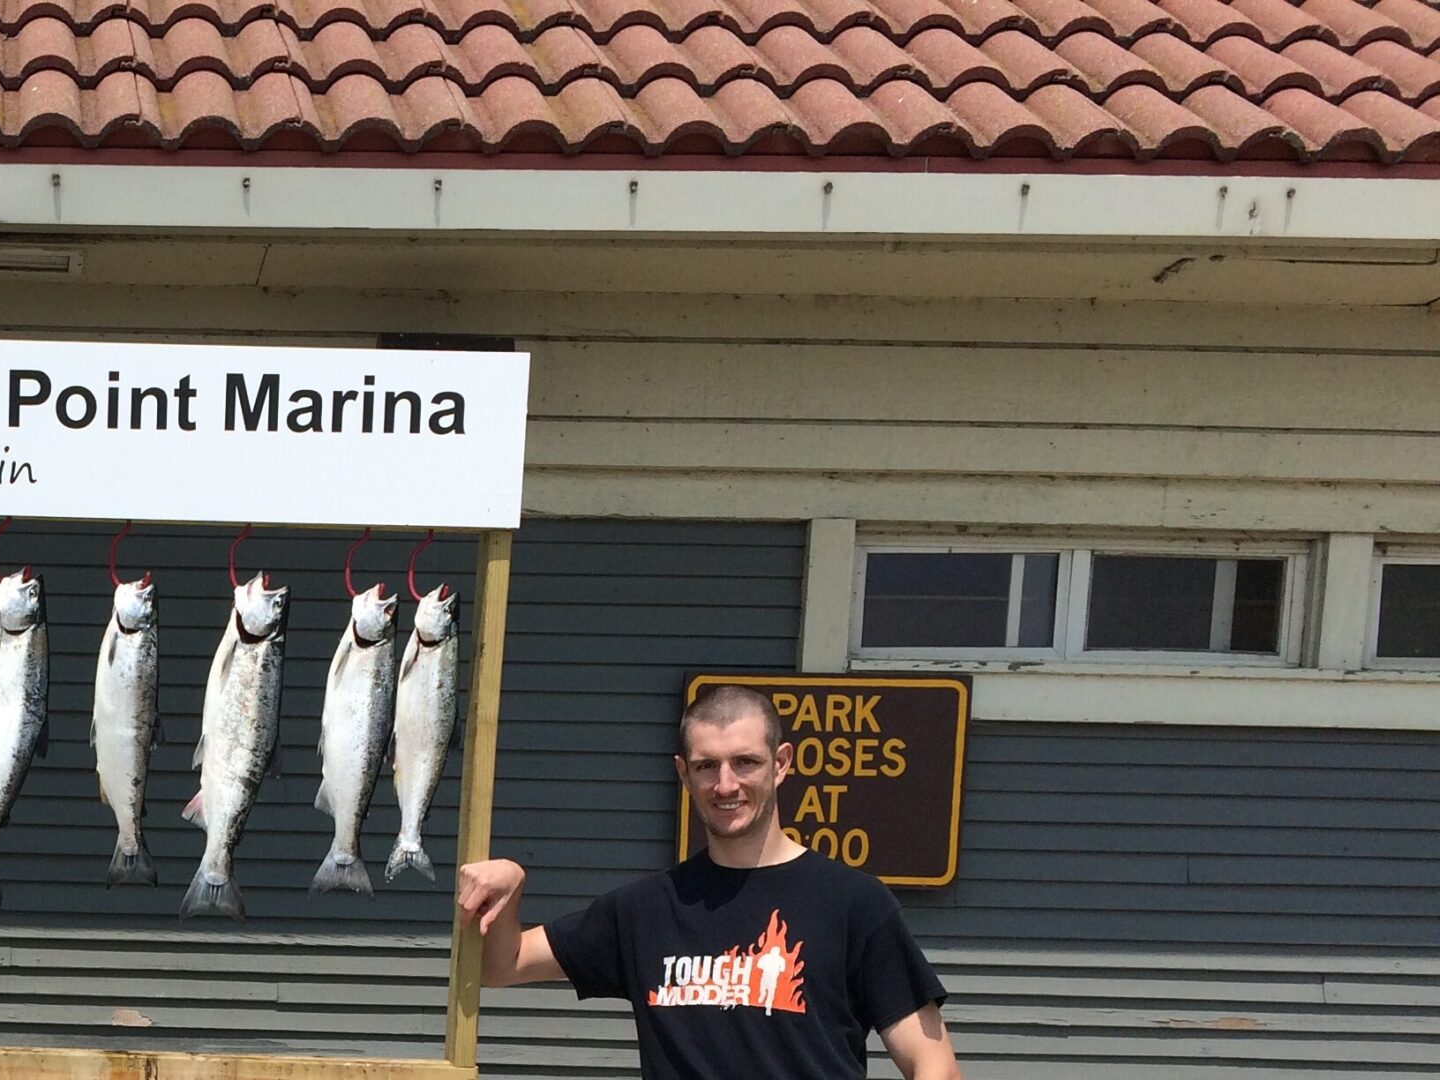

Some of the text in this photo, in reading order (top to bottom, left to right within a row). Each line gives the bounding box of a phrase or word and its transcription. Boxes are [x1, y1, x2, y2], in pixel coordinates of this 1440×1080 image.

[225, 373, 465, 435] Marina
[772, 693, 882, 733] PARK
[786, 737, 907, 777] OSES
[794, 785, 848, 823] AT
[663, 955, 753, 986] TOUGH
[656, 984, 751, 1006] MUDDER
